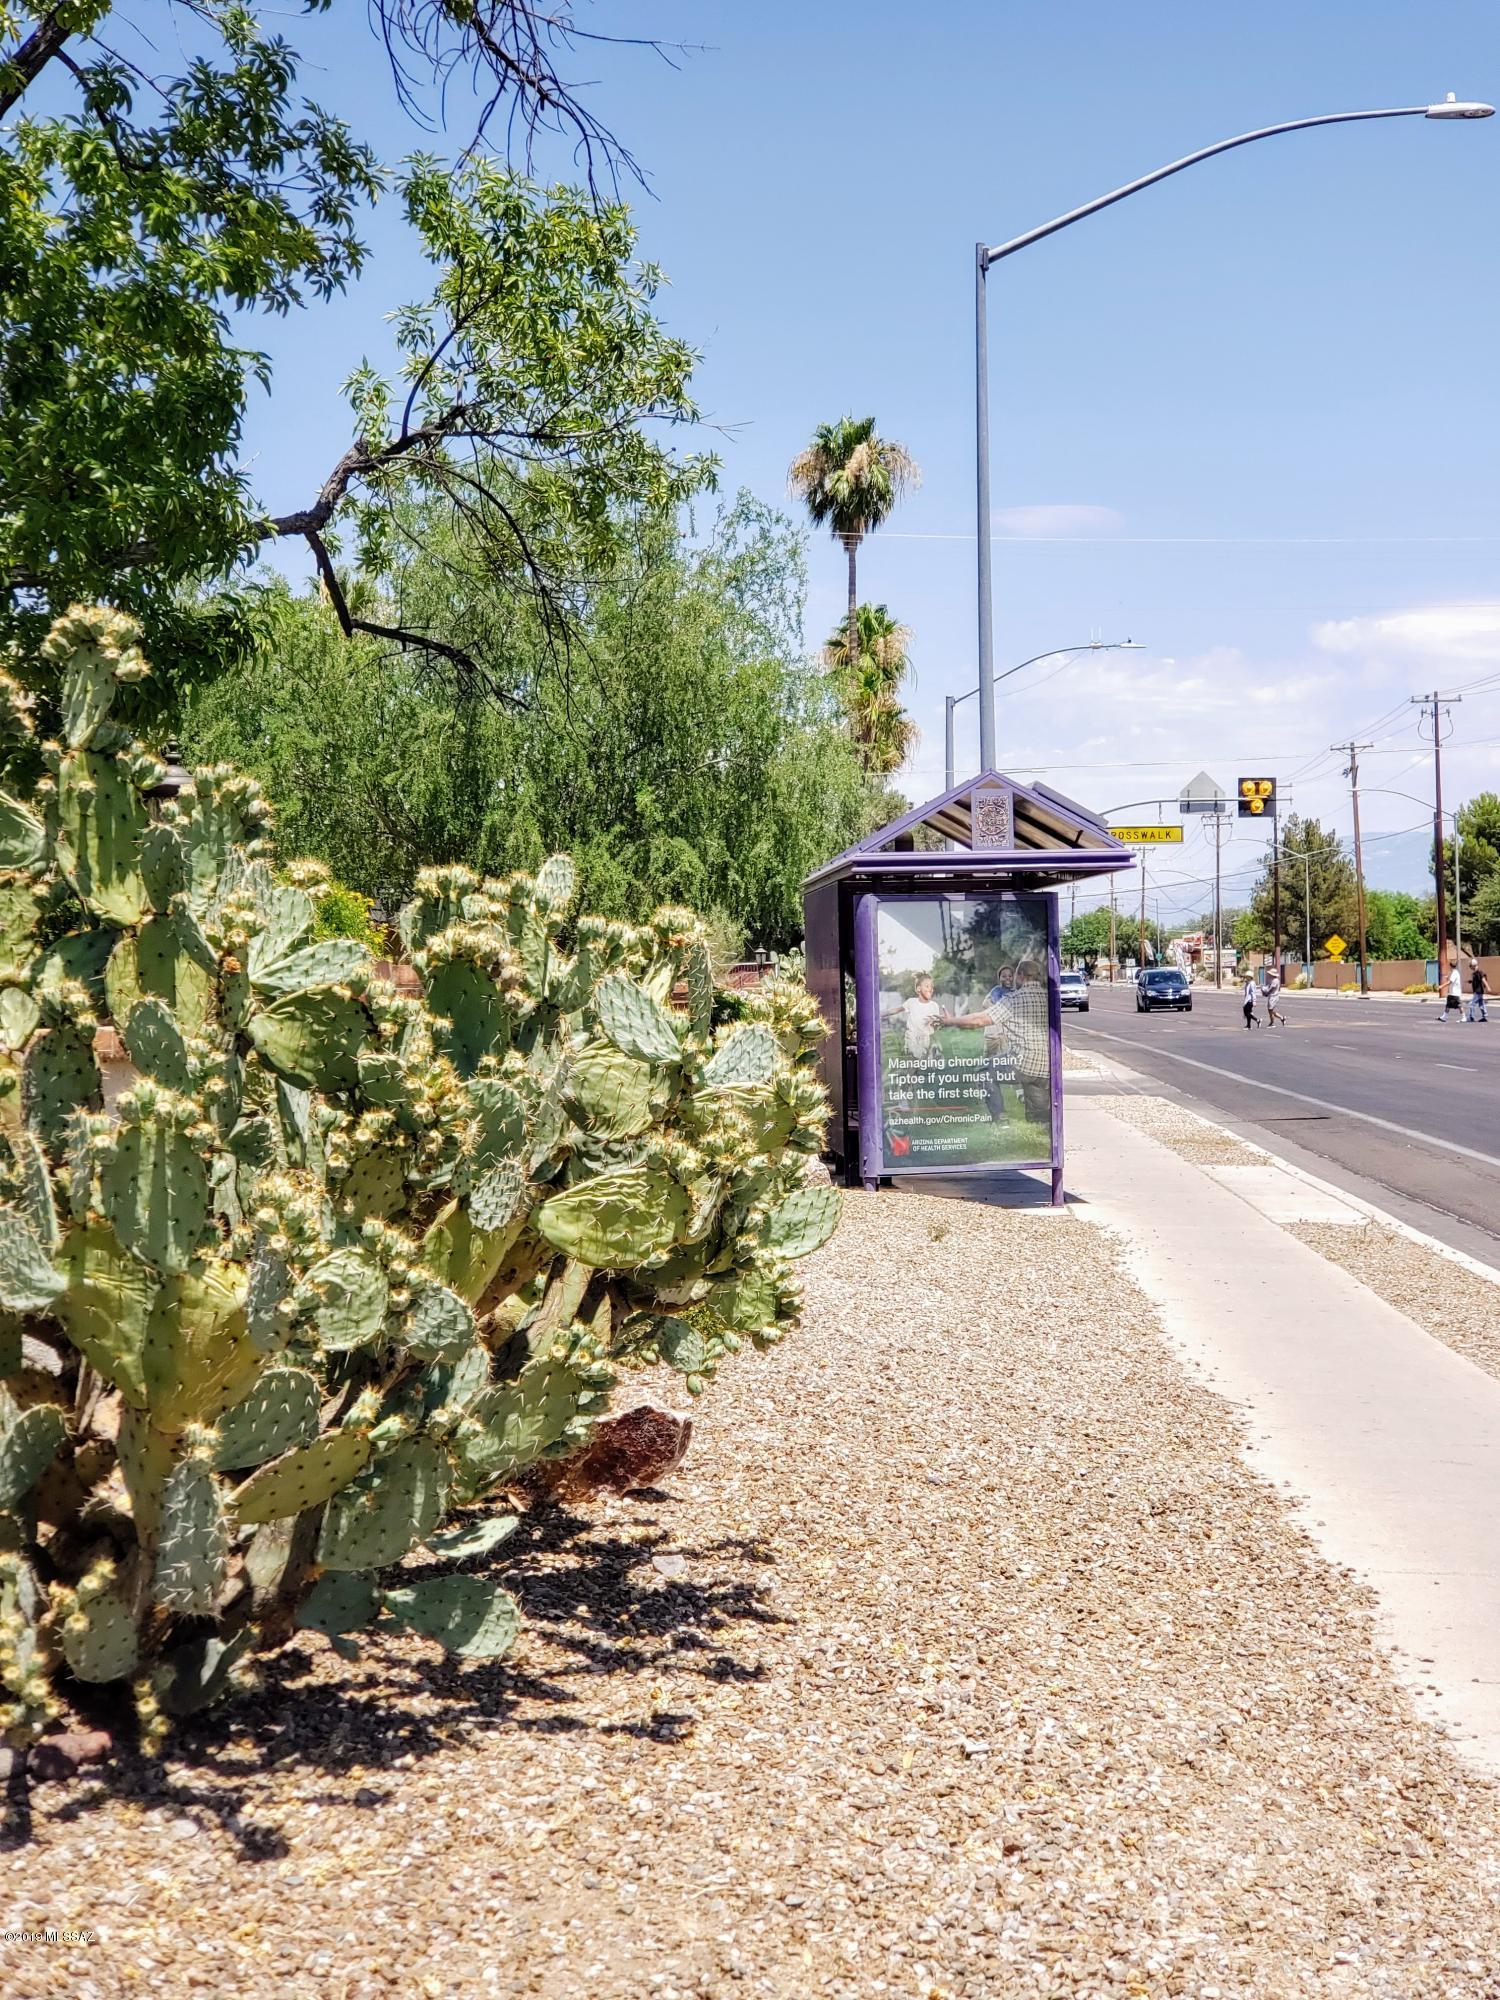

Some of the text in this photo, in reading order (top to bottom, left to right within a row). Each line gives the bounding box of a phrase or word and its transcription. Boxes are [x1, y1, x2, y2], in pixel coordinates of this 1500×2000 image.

[1111, 830, 1172, 840] ROSSWALK
[888, 1054, 1024, 1070] Managing chronic pain?
[888, 1071, 1016, 1086] Tiptoe if you must, but
[889, 1088, 991, 1100] take the first step.
[889, 1114, 992, 1126] azhealth.gov/ChronicPain
[934, 1137, 968, 1145] DEPARTMENT
